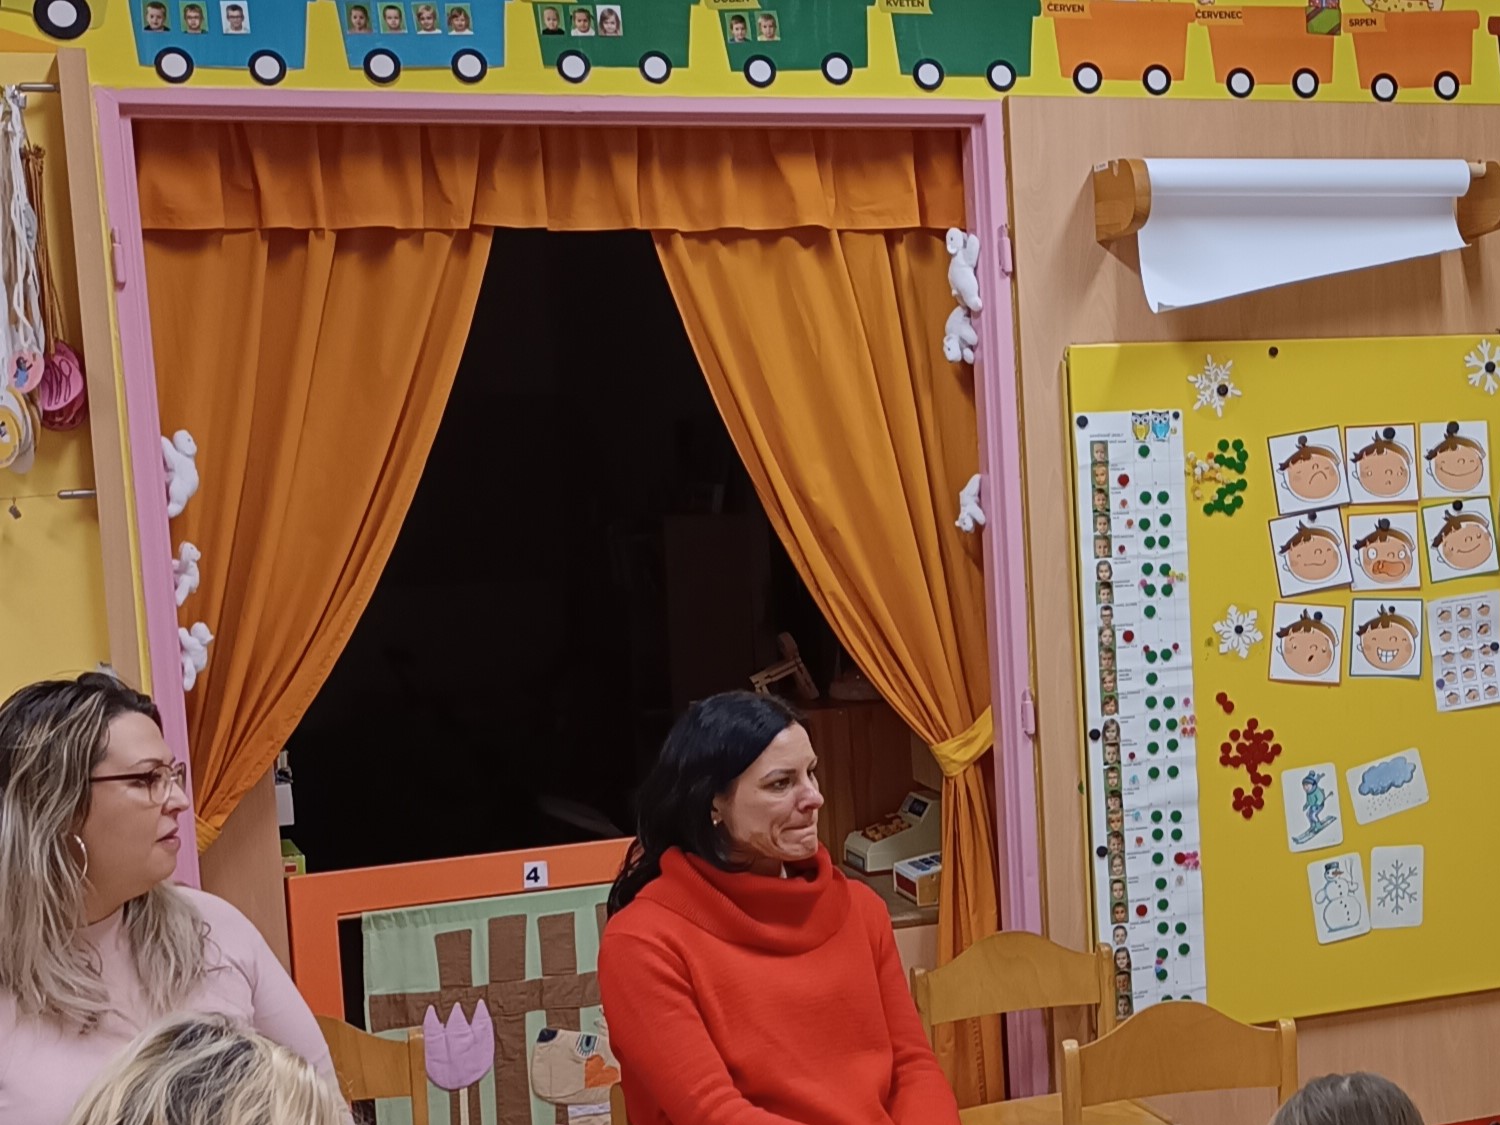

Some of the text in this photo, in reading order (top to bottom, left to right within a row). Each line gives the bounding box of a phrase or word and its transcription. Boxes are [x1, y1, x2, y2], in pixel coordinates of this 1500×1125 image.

[1047, 3, 1085, 13] ČERVEN
[1195, 9, 1243, 19] ČERVENEC
[1349, 18, 1377, 27] SRPEN
[525, 866, 540, 883] 4
